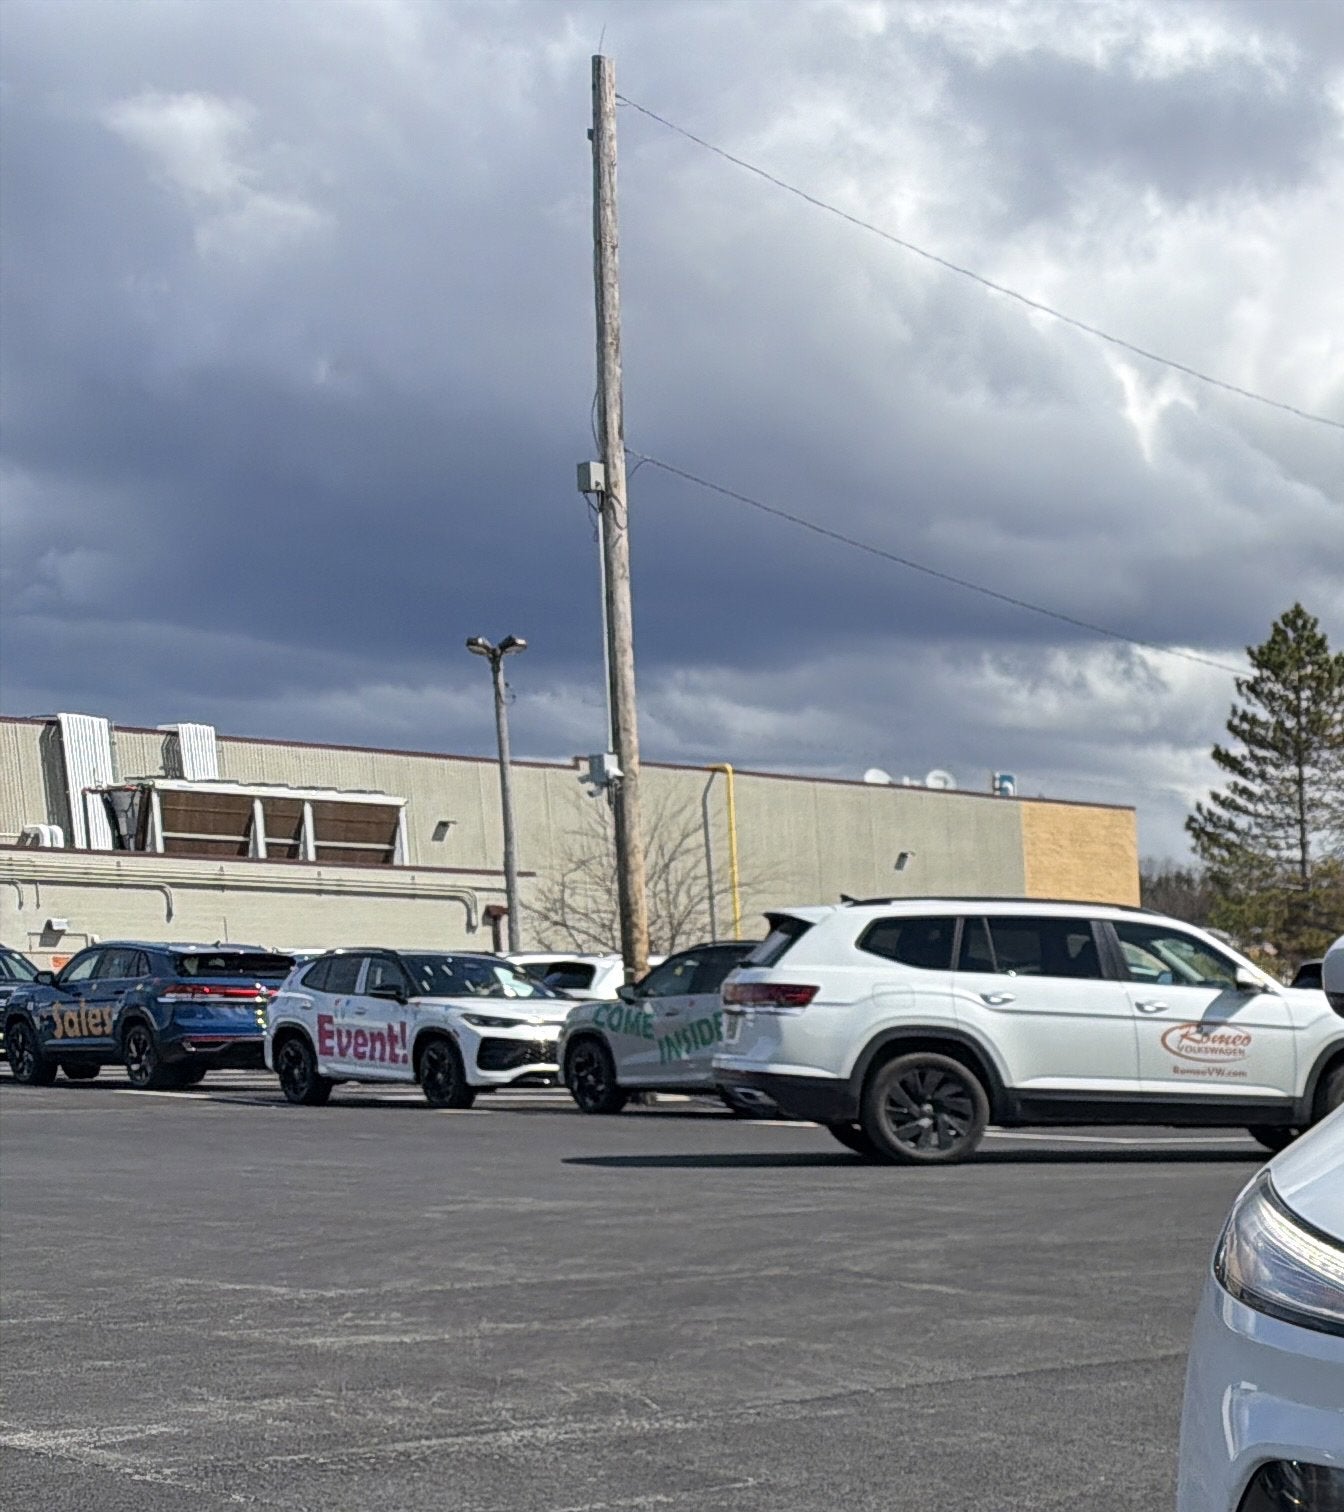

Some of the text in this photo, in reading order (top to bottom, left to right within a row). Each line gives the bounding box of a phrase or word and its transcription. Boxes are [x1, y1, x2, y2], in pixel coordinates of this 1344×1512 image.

[52, 998, 113, 1039] Sales
[317, 1014, 408, 1064] Event!
[593, 1003, 655, 1039] COME
